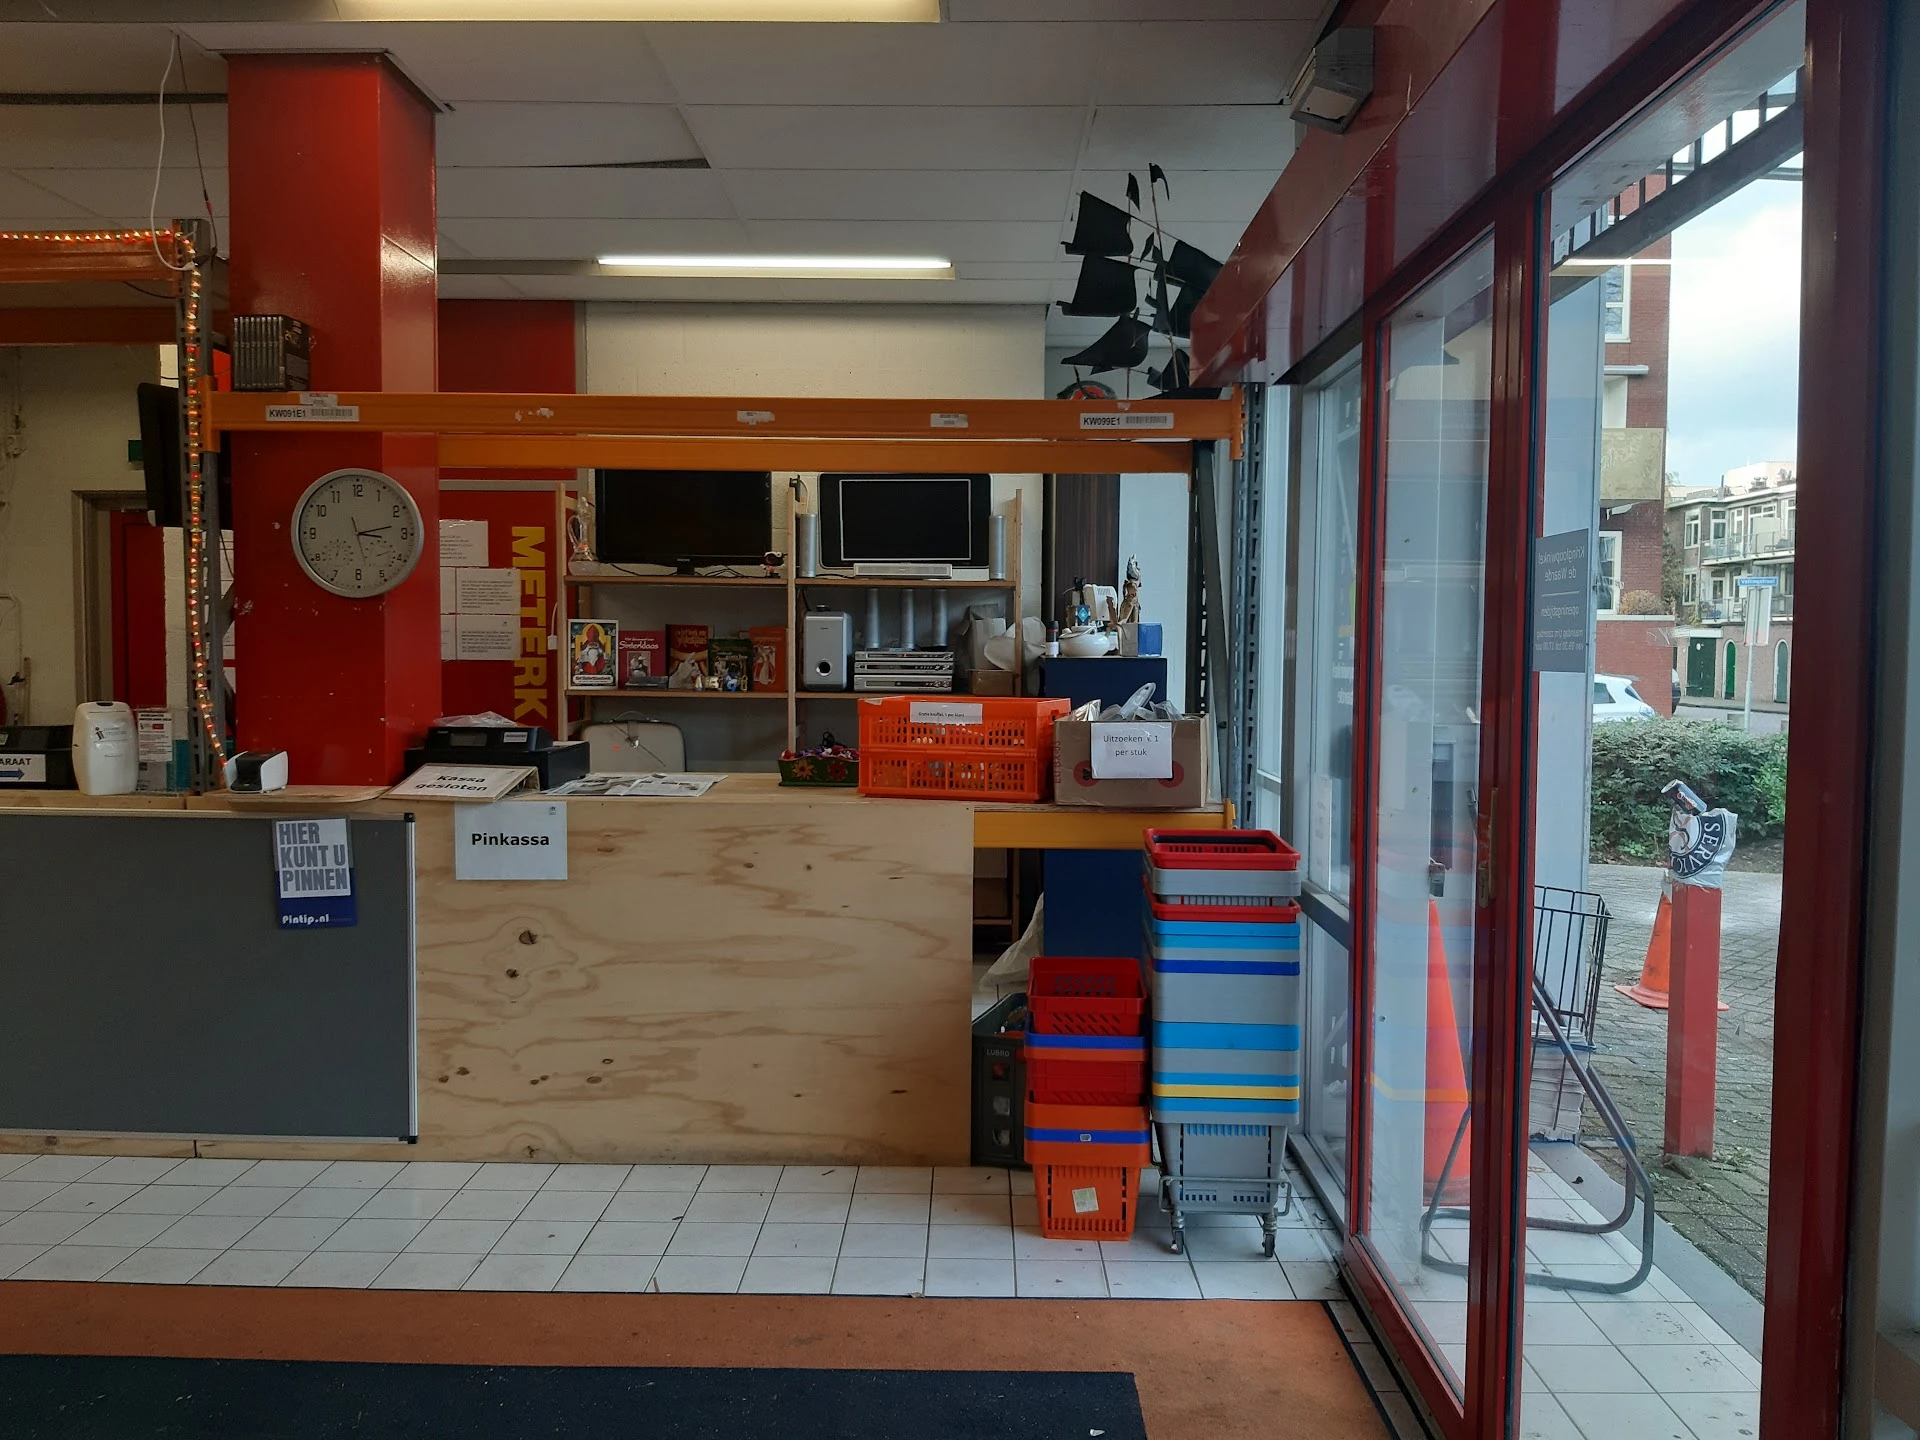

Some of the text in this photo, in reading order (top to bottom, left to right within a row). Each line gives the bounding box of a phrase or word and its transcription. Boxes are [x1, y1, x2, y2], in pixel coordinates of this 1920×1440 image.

[269, 408, 306, 418] KW091E1
[1083, 415, 1121, 427] KW099E1
[331, 490, 342, 504] 11
[353, 484, 364, 497] 12
[317, 504, 328, 519] 10
[392, 504, 401, 519] 2
[310, 526, 318, 541] 9
[400, 527, 409, 541] 3
[396, 553, 404, 562] 4
[332, 568, 339, 579] 7
[379, 569, 386, 579] 5
[512, 526, 548, 727] METERK
[1103, 734, 1143, 743] Uitzoeken
[1154, 735, 1159, 743] 1
[1115, 748, 1147, 758] per stuk
[0, 757, 32, 766] ARAAT
[436, 775, 486, 783] Kassa
[415, 782, 488, 791] gesloten
[279, 822, 321, 845] HIER
[471, 833, 550, 846] Pinkassa
[279, 844, 346, 868] KUNT U
[282, 867, 348, 891] PINNEN
[281, 913, 331, 926] Pintip.nl
[986, 1048, 1010, 1057] LUBRO
